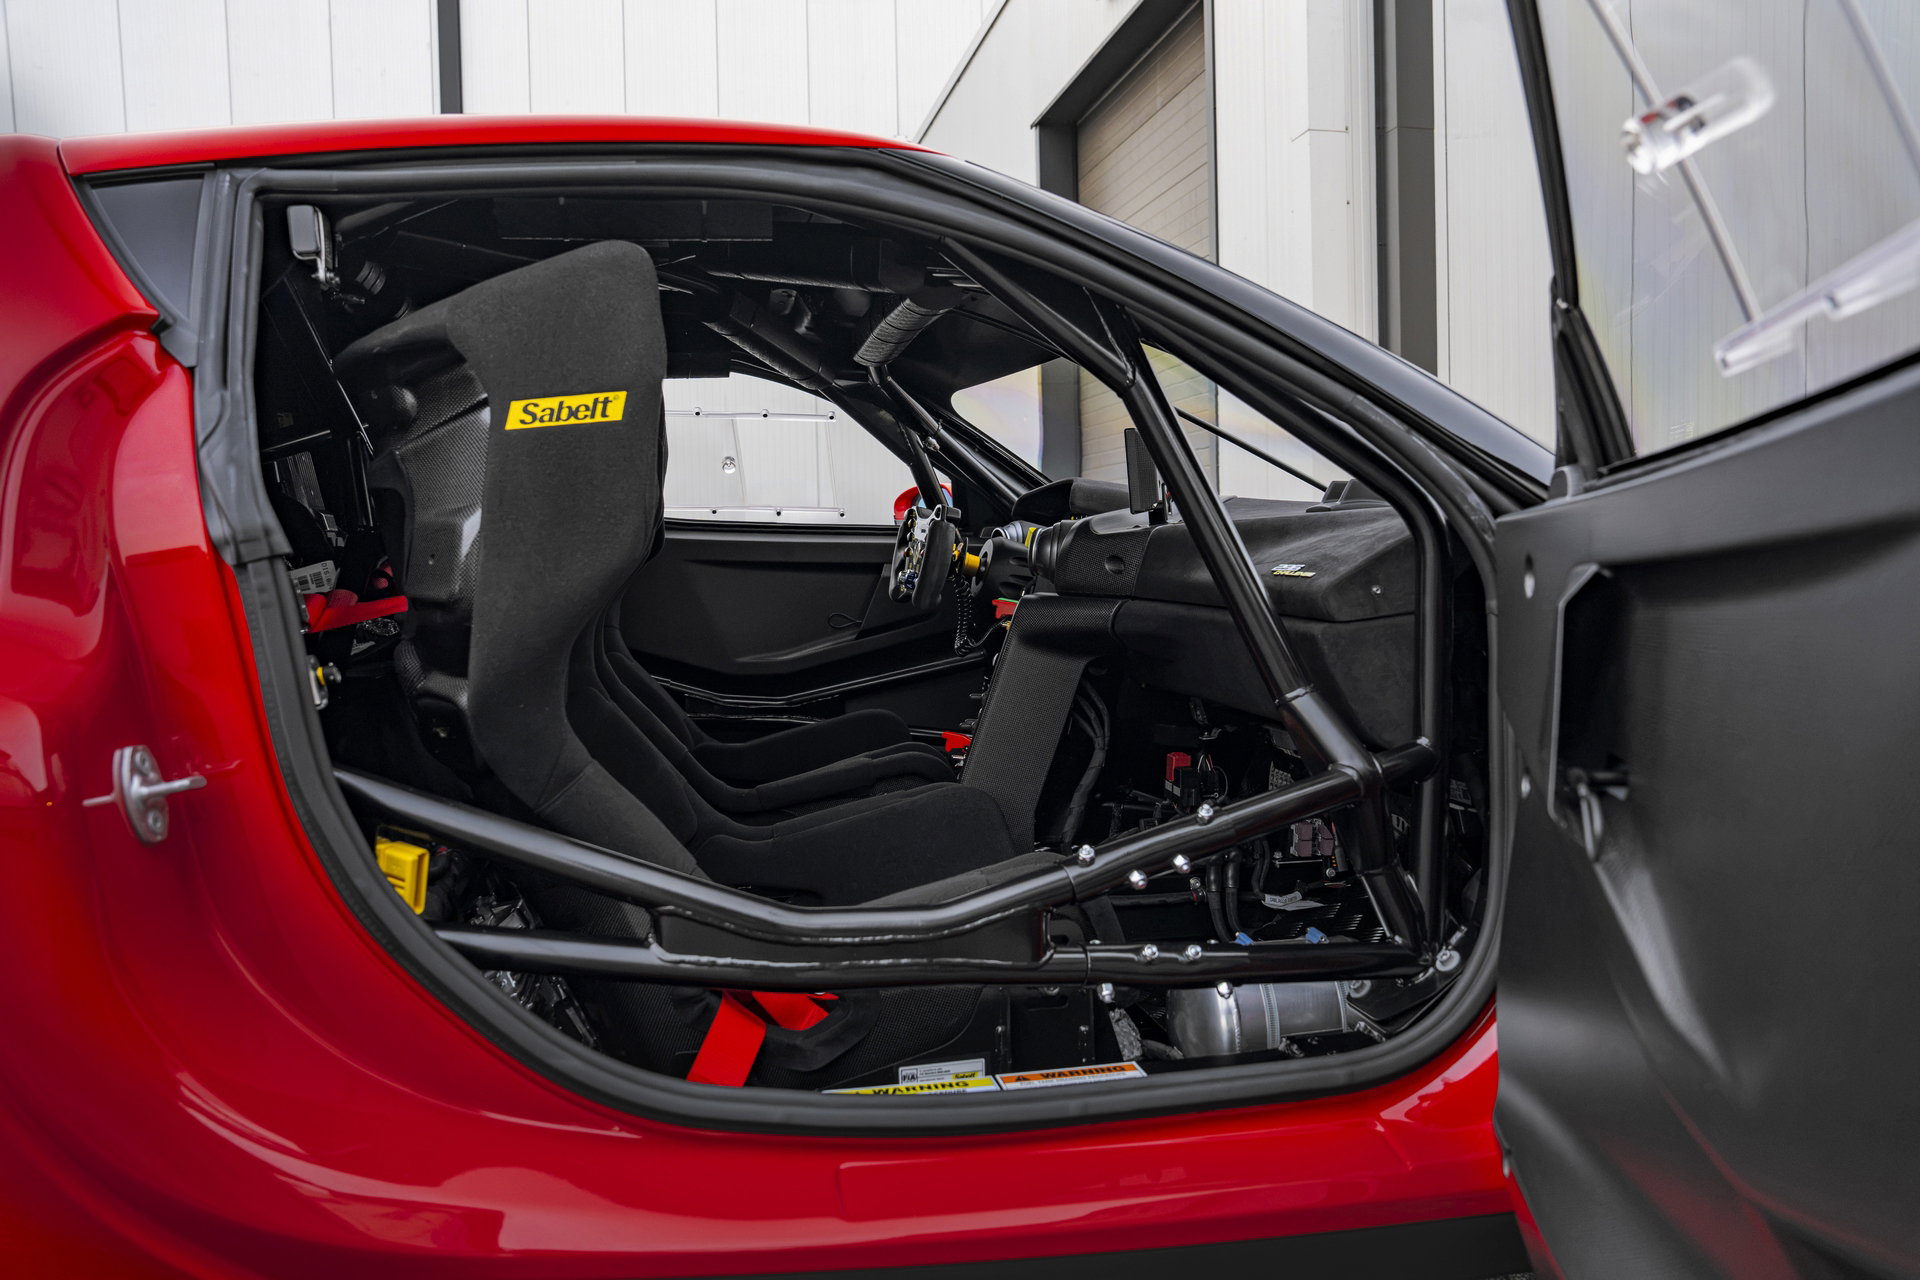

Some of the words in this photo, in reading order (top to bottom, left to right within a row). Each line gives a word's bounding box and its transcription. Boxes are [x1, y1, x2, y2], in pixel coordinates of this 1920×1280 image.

[519, 396, 613, 425] Sabelt
[1040, 1066, 1126, 1079] WARNING
[871, 1081, 969, 1095] WARNING
